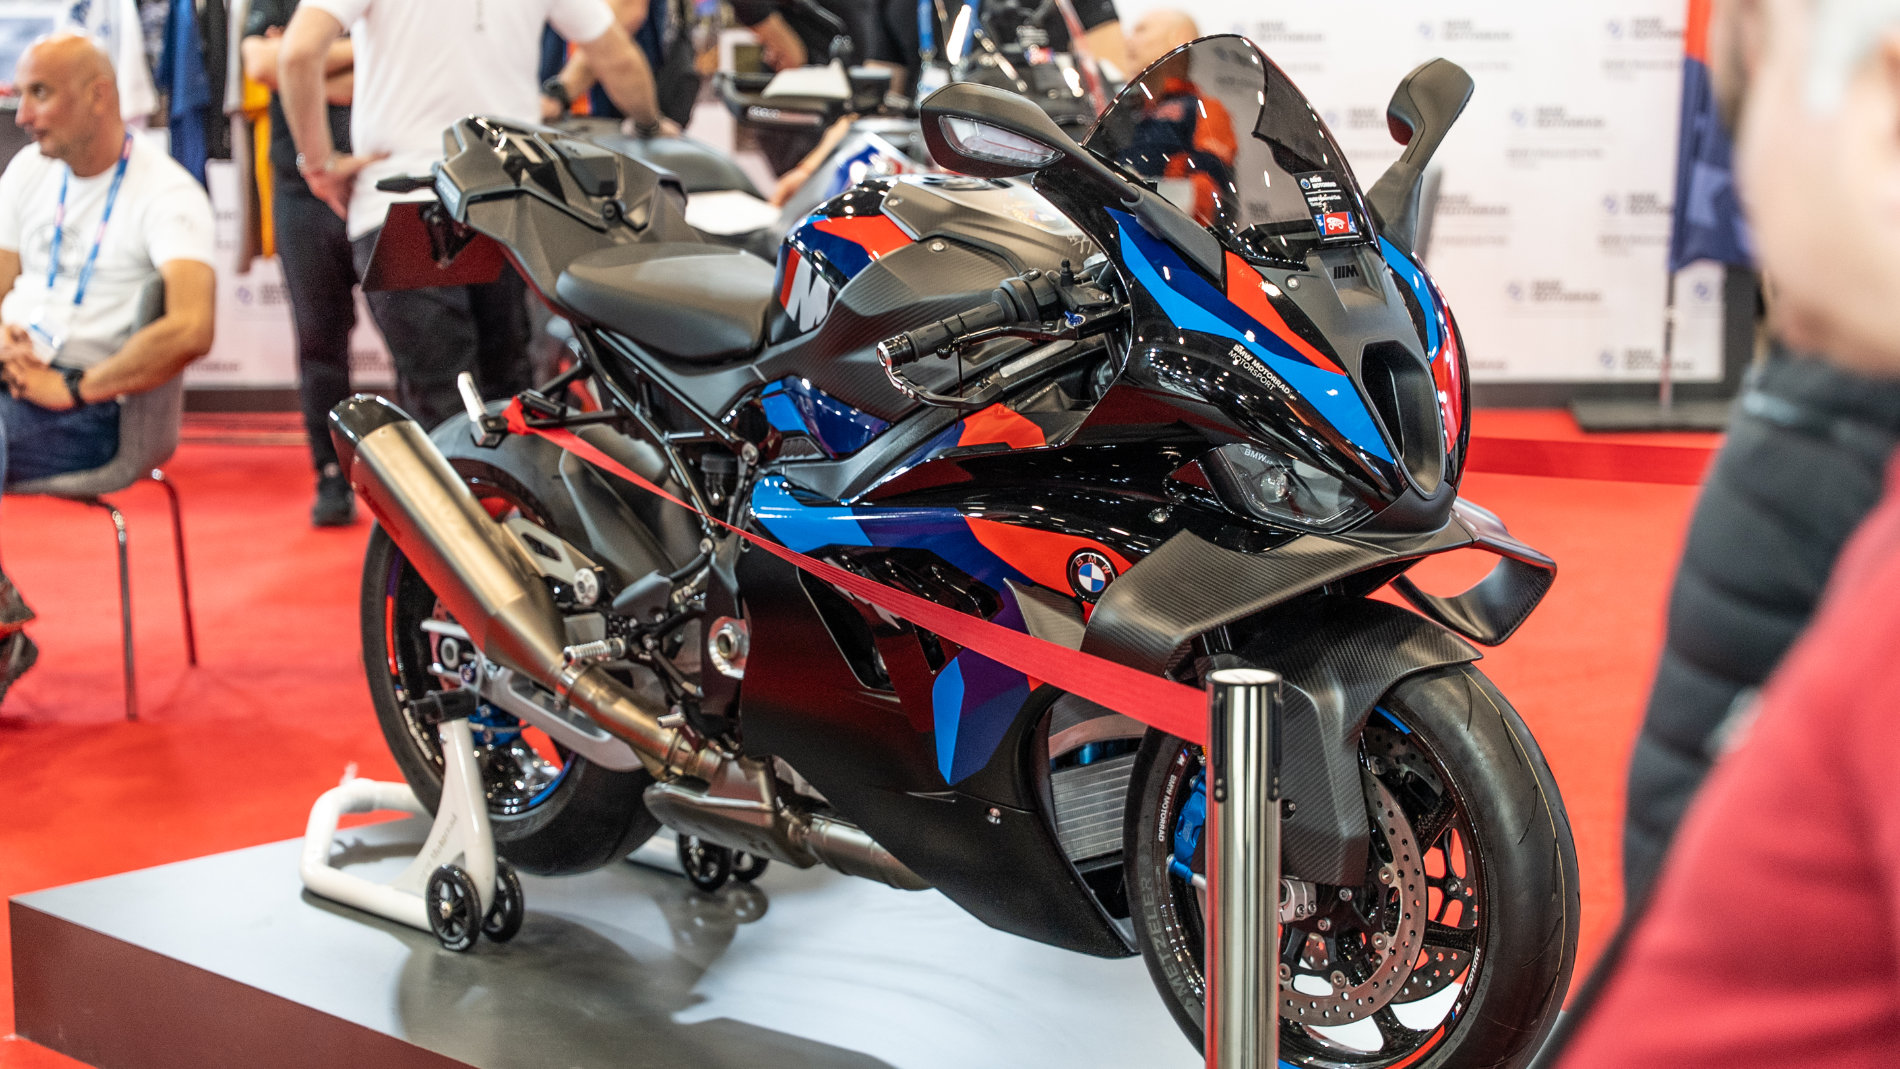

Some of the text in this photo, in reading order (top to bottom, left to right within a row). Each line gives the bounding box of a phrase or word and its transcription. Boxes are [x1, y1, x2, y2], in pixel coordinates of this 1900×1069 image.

[1228, 350, 1276, 390] MOTORSPORT
[1232, 344, 1291, 394] BMW MOTORRAD
[1244, 448, 1267, 461] BMW
[1158, 774, 1177, 842] BMW MOTORRAD
[1141, 877, 1188, 996] METZELER
